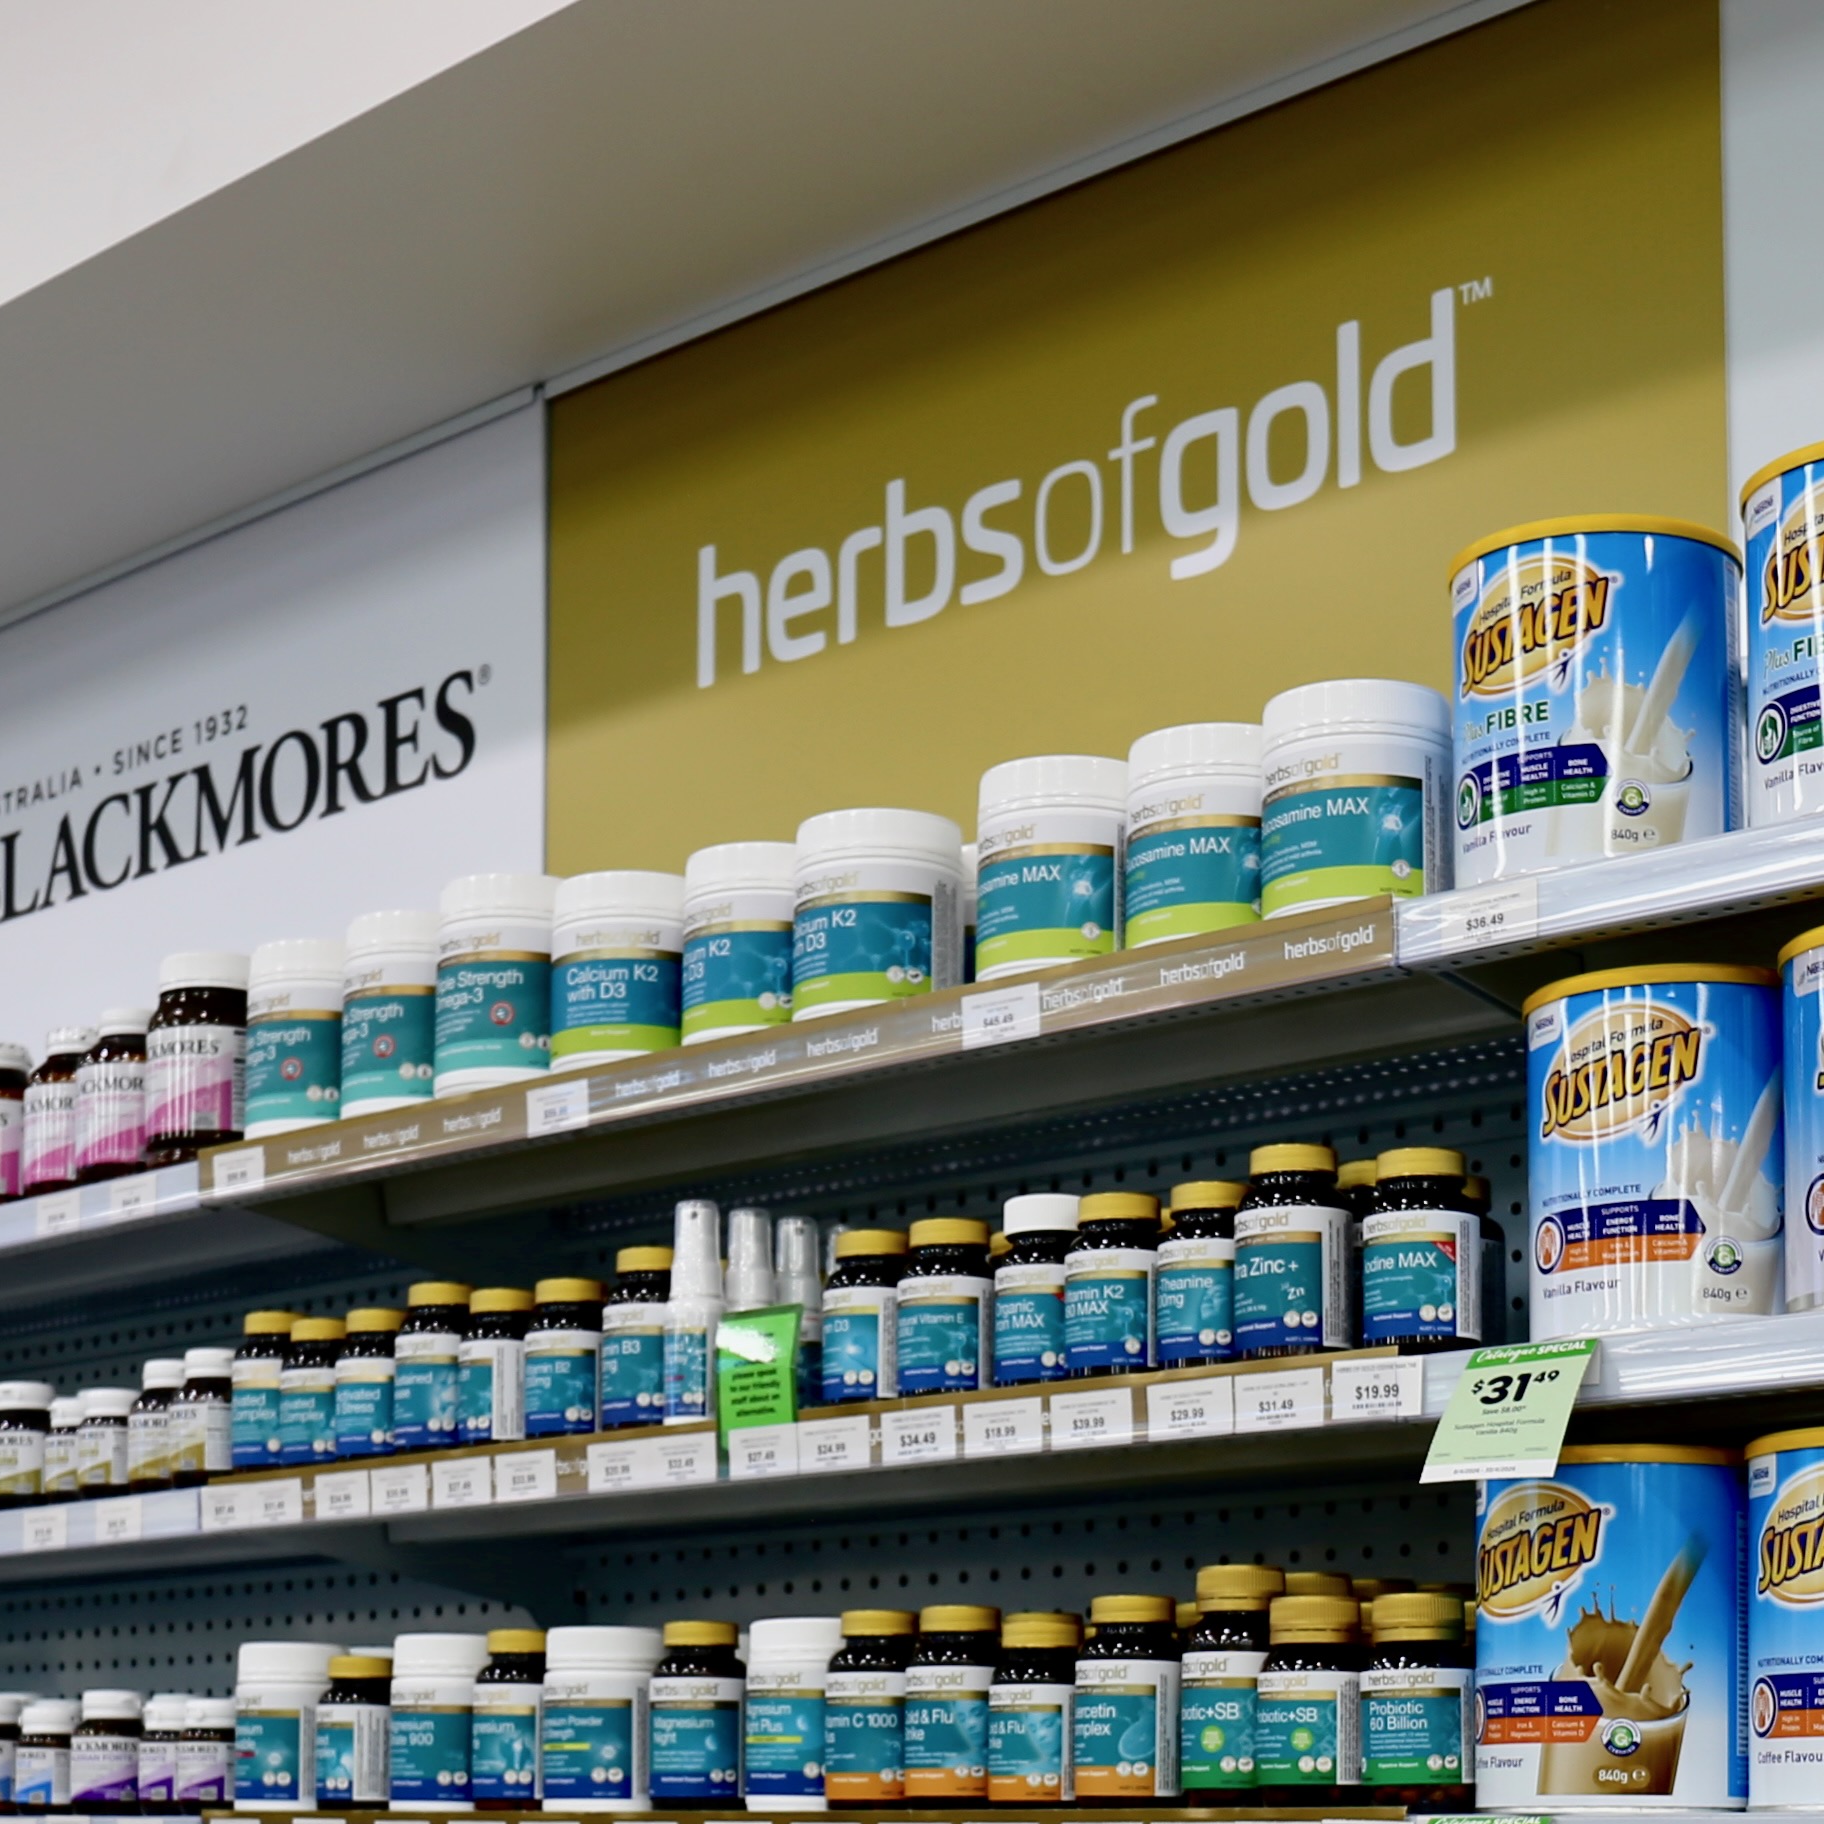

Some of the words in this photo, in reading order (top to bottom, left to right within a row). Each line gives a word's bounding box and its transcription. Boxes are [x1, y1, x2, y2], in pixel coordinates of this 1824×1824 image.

[112, 732, 184, 776] SINCE
[193, 706, 250, 746] 1932
[1464, 912, 1504, 931] $36.49
[457, 968, 524, 988] Strength
[566, 966, 629, 985] Calcium
[632, 964, 658, 982] K2
[567, 985, 595, 1002] with
[599, 981, 627, 999] D3
[1250, 1258, 1285, 1276] Zinc
[1398, 1251, 1437, 1269] MAX
[1354, 1383, 1400, 1402] $19.99
[1369, 1701, 1425, 1716] Probiotic
[1369, 1716, 1385, 1731] 60
[1387, 1716, 1429, 1732] Billion
[1757, 1749, 1781, 1765] Coffee
